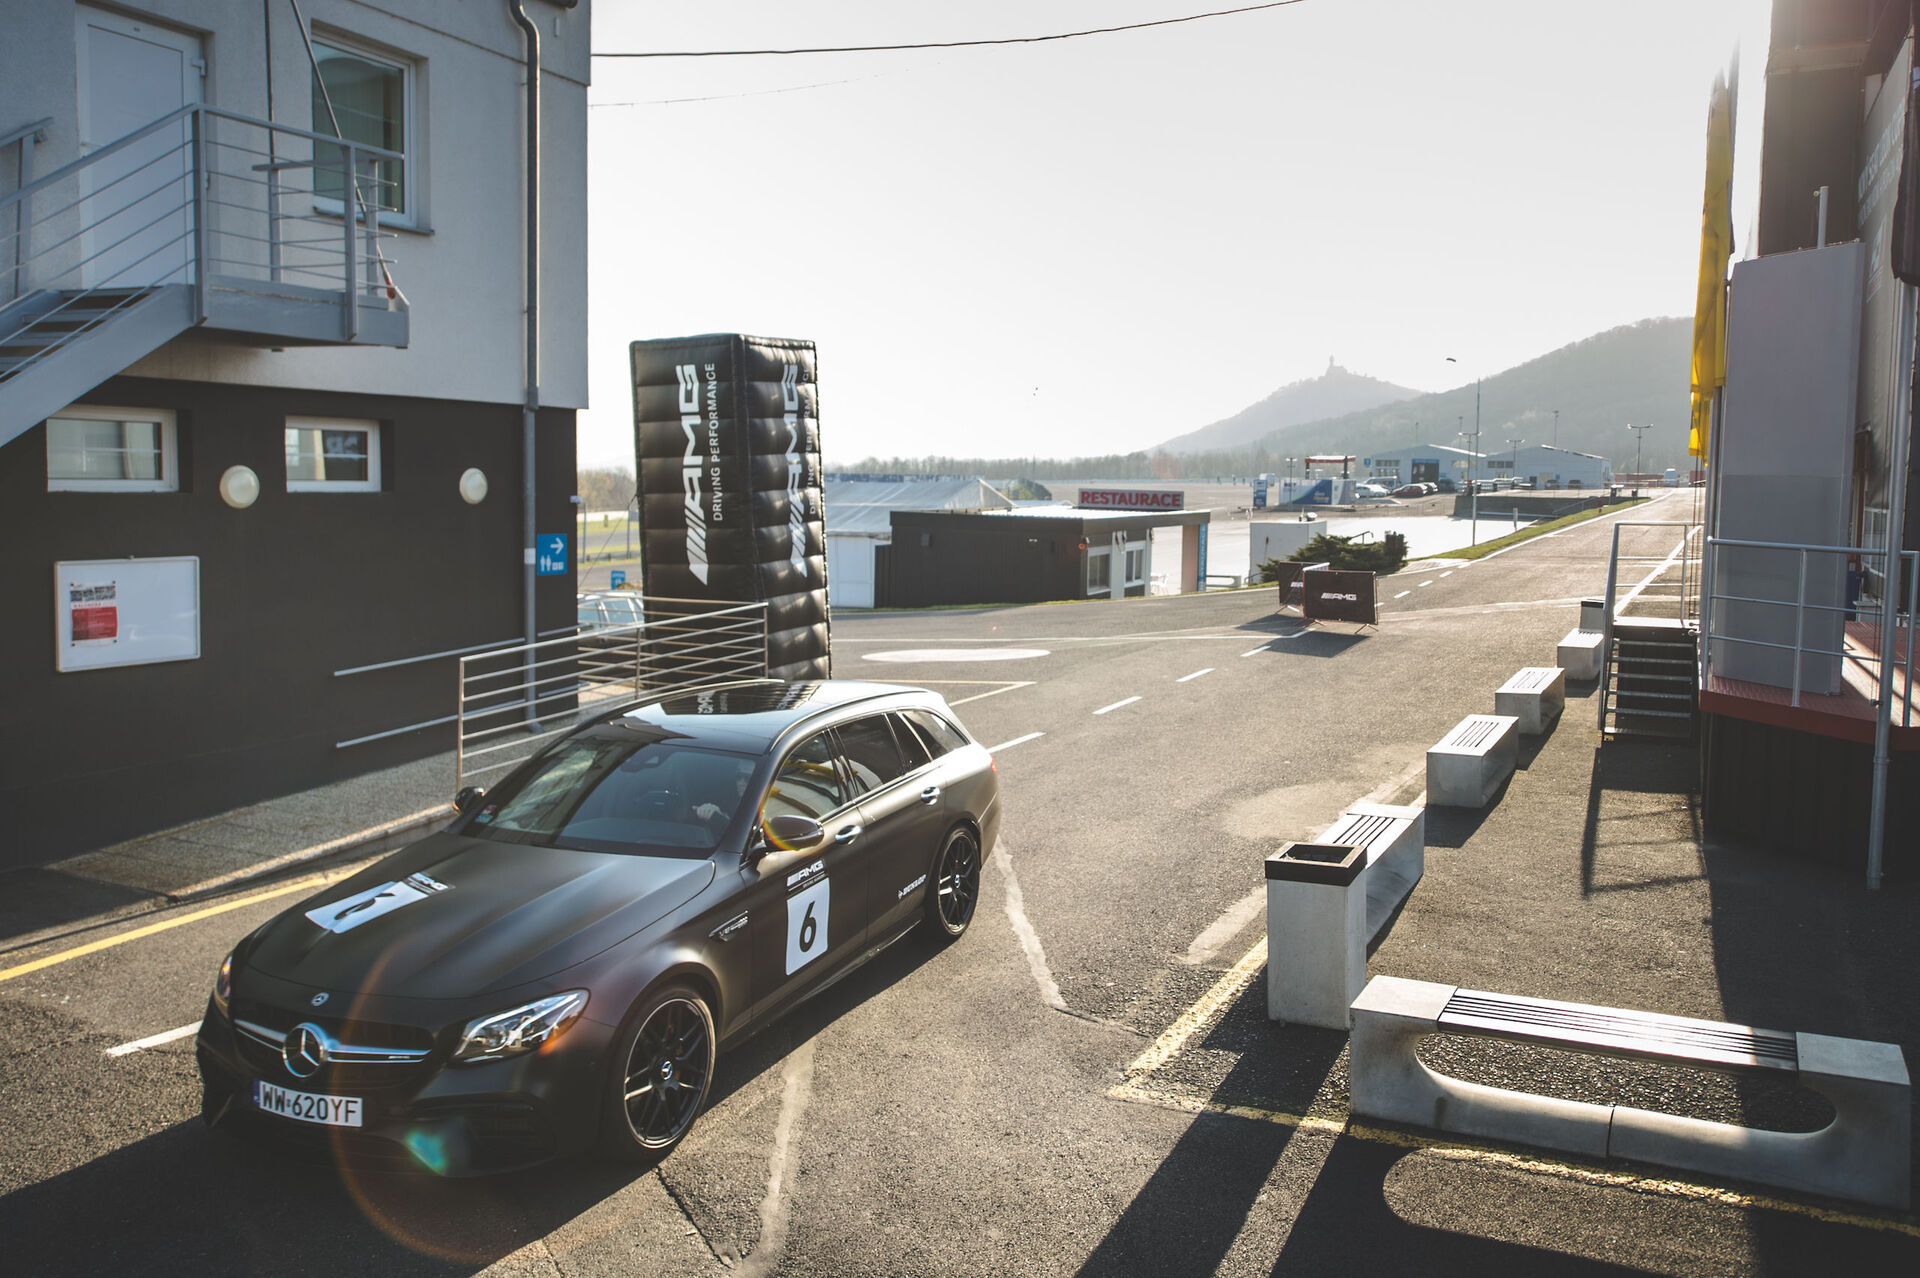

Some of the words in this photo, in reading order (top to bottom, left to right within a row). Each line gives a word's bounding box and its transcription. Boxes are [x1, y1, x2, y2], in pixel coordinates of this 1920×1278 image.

[704, 363, 721, 463] PERFORMANCE
[802, 367, 813, 459] ERFRMACE
[676, 365, 706, 540] AMG
[711, 466, 723, 521] DRIVING
[805, 465, 816, 515] DRING
[1081, 491, 1181, 507] RESTAURACE
[793, 860, 824, 884] AMG
[799, 900, 817, 953] 6
[262, 1083, 286, 1113] WW
[292, 1094, 358, 1123] 620YF
